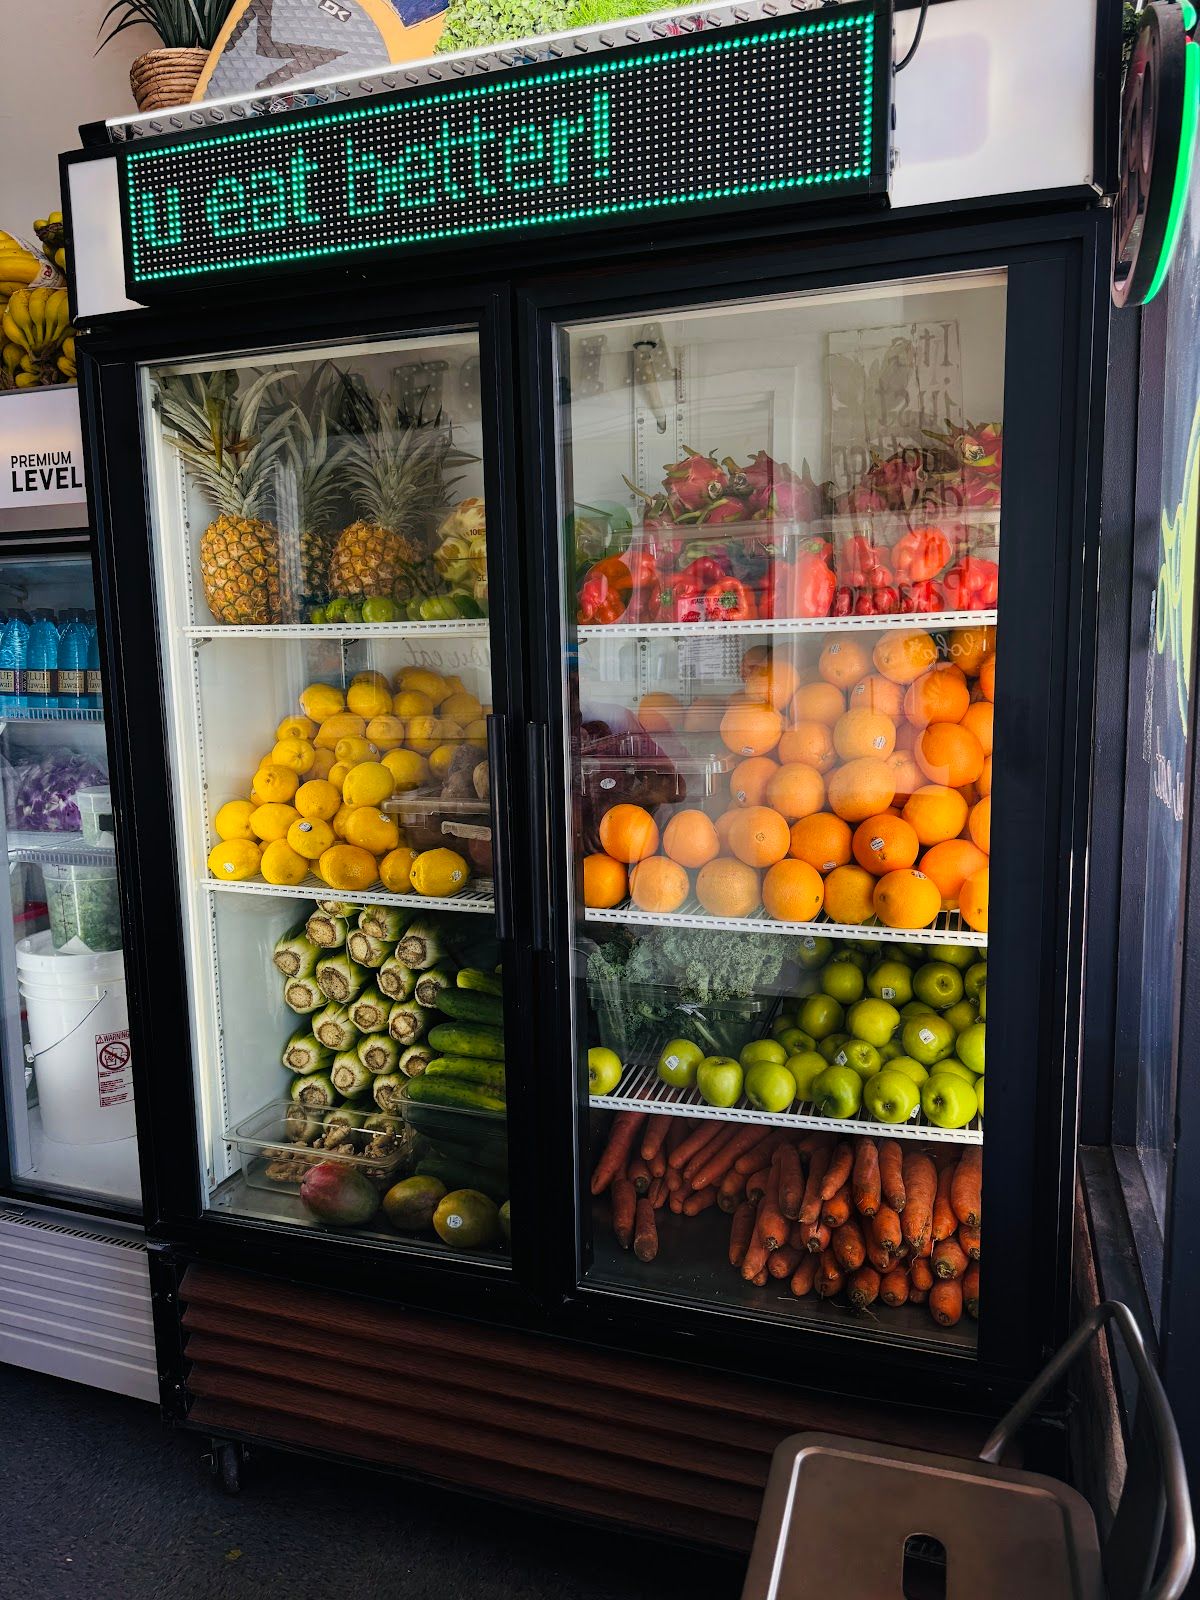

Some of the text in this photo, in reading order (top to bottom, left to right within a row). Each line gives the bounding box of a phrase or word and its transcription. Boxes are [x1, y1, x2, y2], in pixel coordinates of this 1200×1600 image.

[205, 146, 321, 237] eat
[346, 91, 610, 216] better!
[11, 450, 72, 468] PREMIUM
[12, 466, 83, 493] LEVEL
